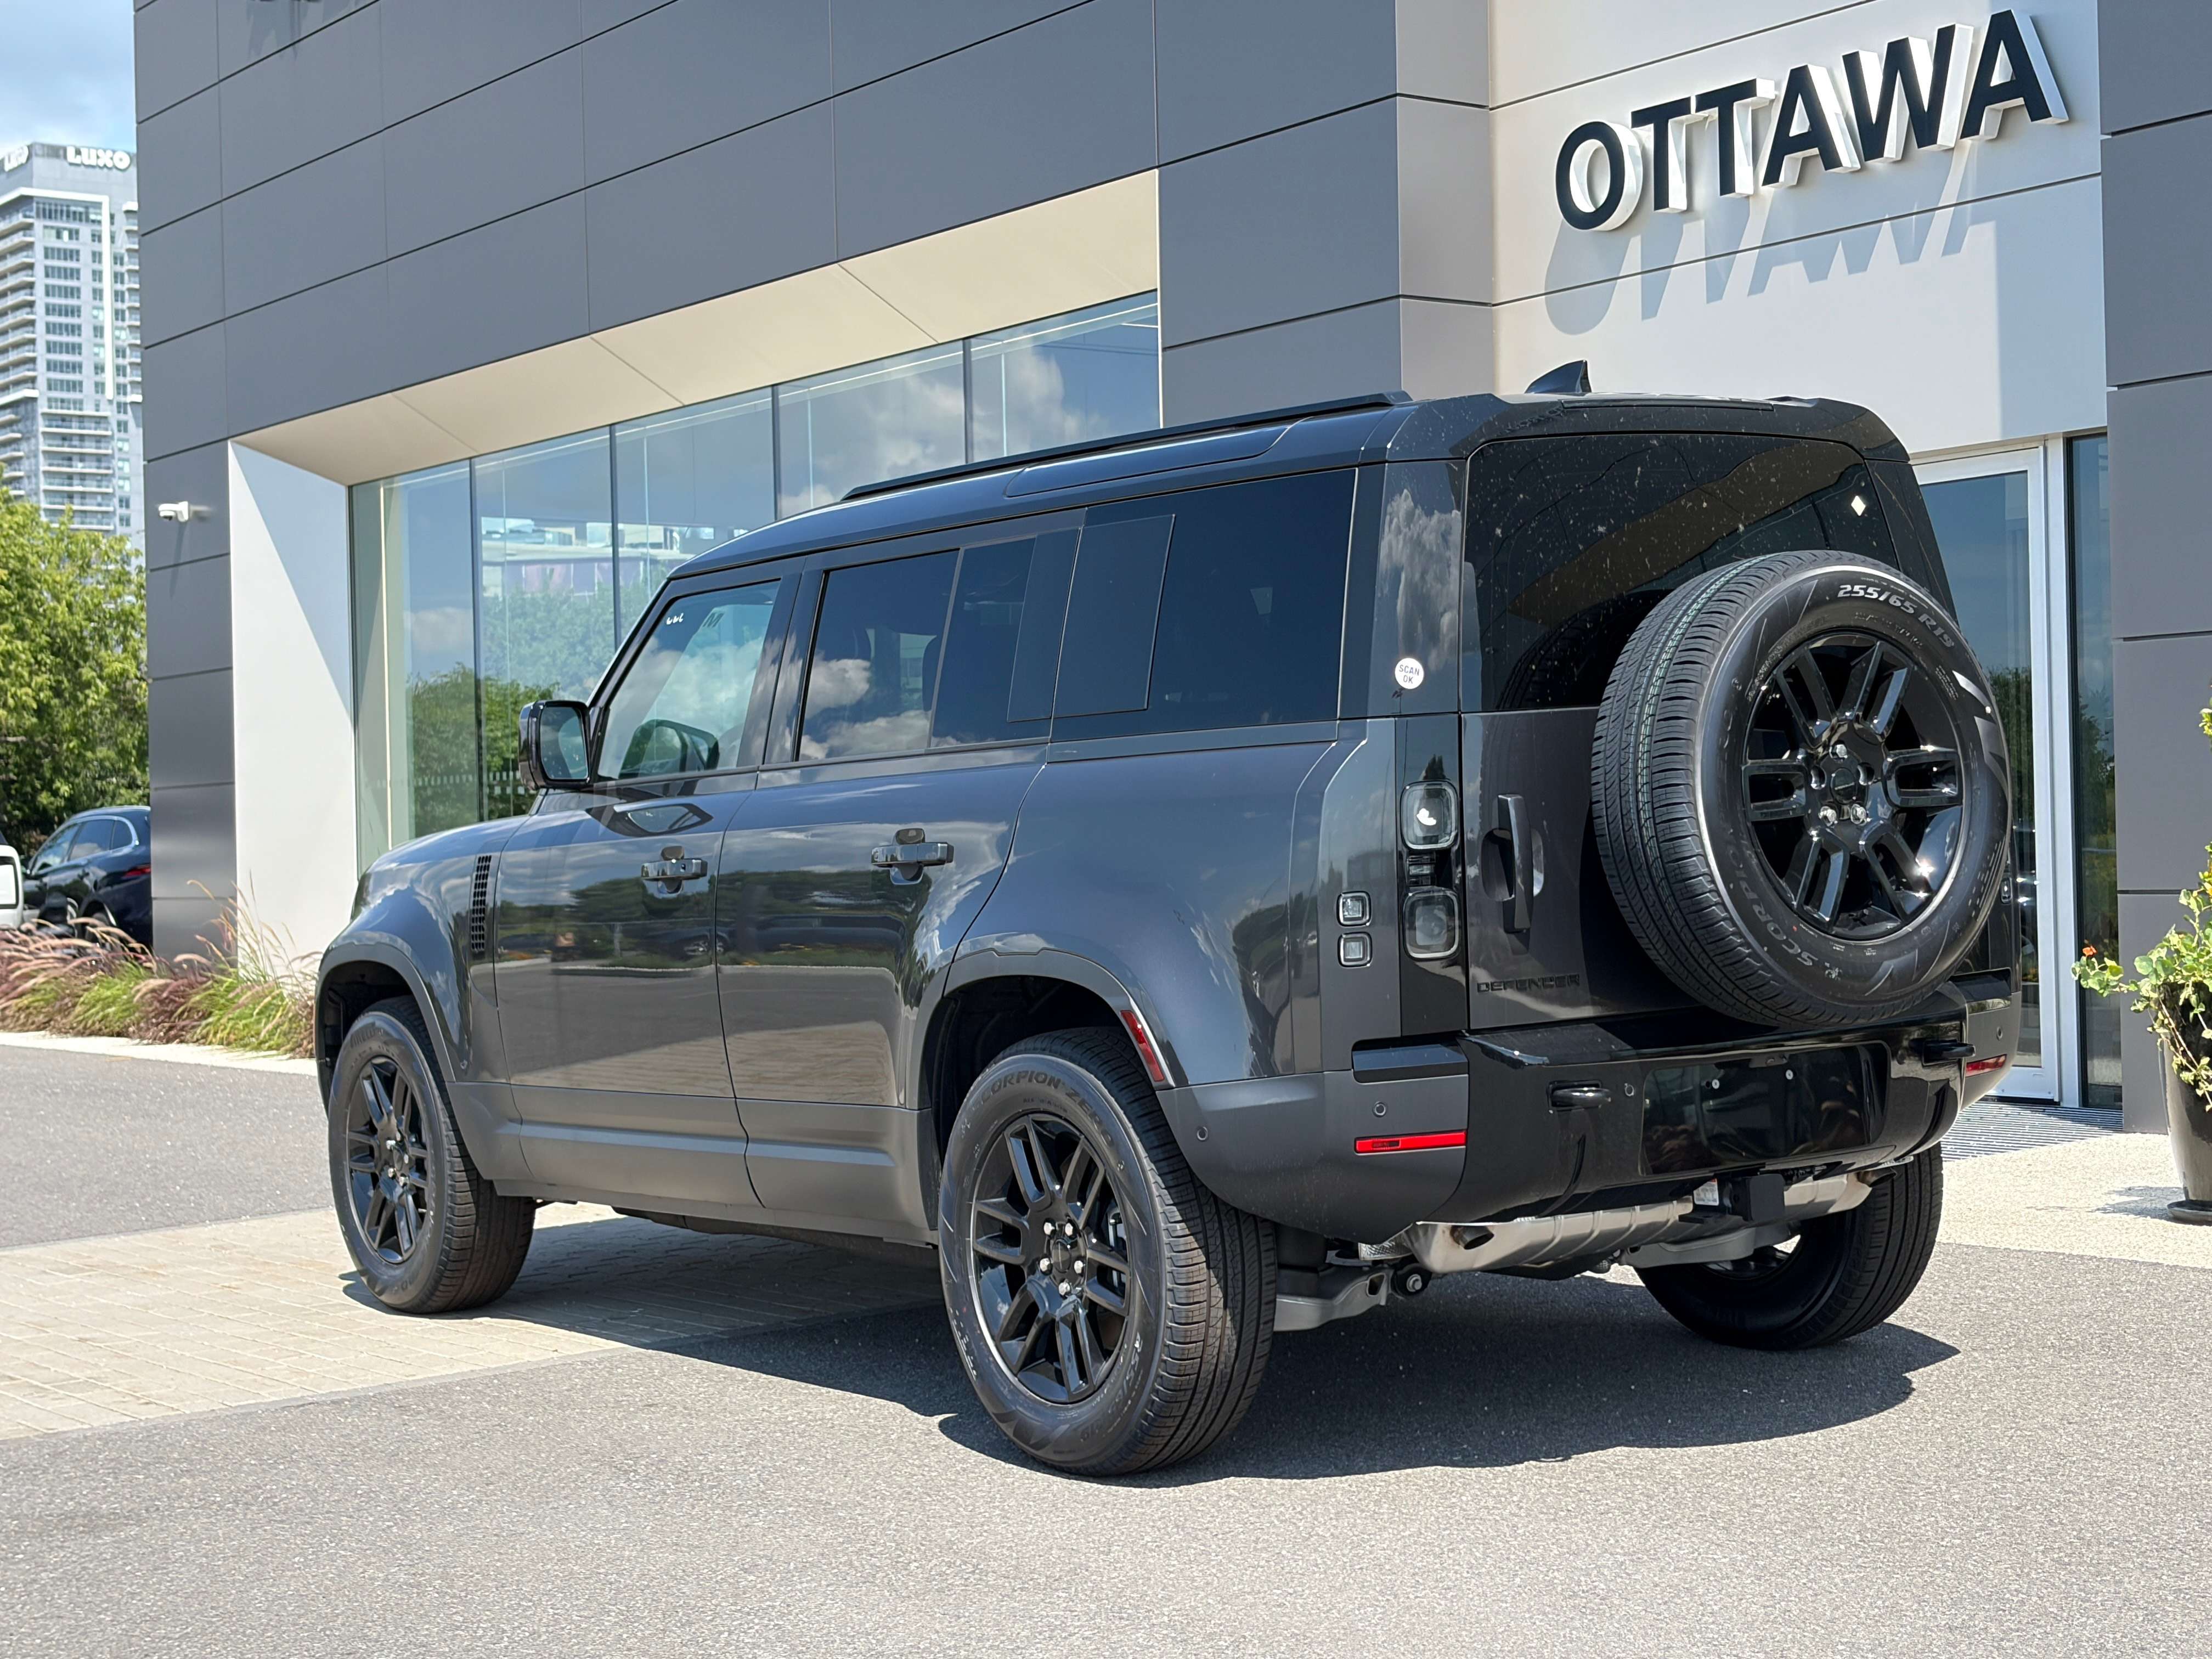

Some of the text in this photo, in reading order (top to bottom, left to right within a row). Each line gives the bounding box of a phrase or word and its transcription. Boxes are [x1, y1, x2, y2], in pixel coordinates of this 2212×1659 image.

[1556, 9, 2058, 231] OTTAWA
[66, 145, 131, 170] LUXO
[1837, 584, 1917, 614] 255/65
[1918, 613, 1955, 647] R19
[1398, 664, 1420, 676] SCAN
[1403, 675, 1414, 684] OK
[1727, 826, 1819, 966] SCORPIO
[1476, 973, 1580, 993] DEFENDER
[972, 1070, 1115, 1147] CORPION ZERO
